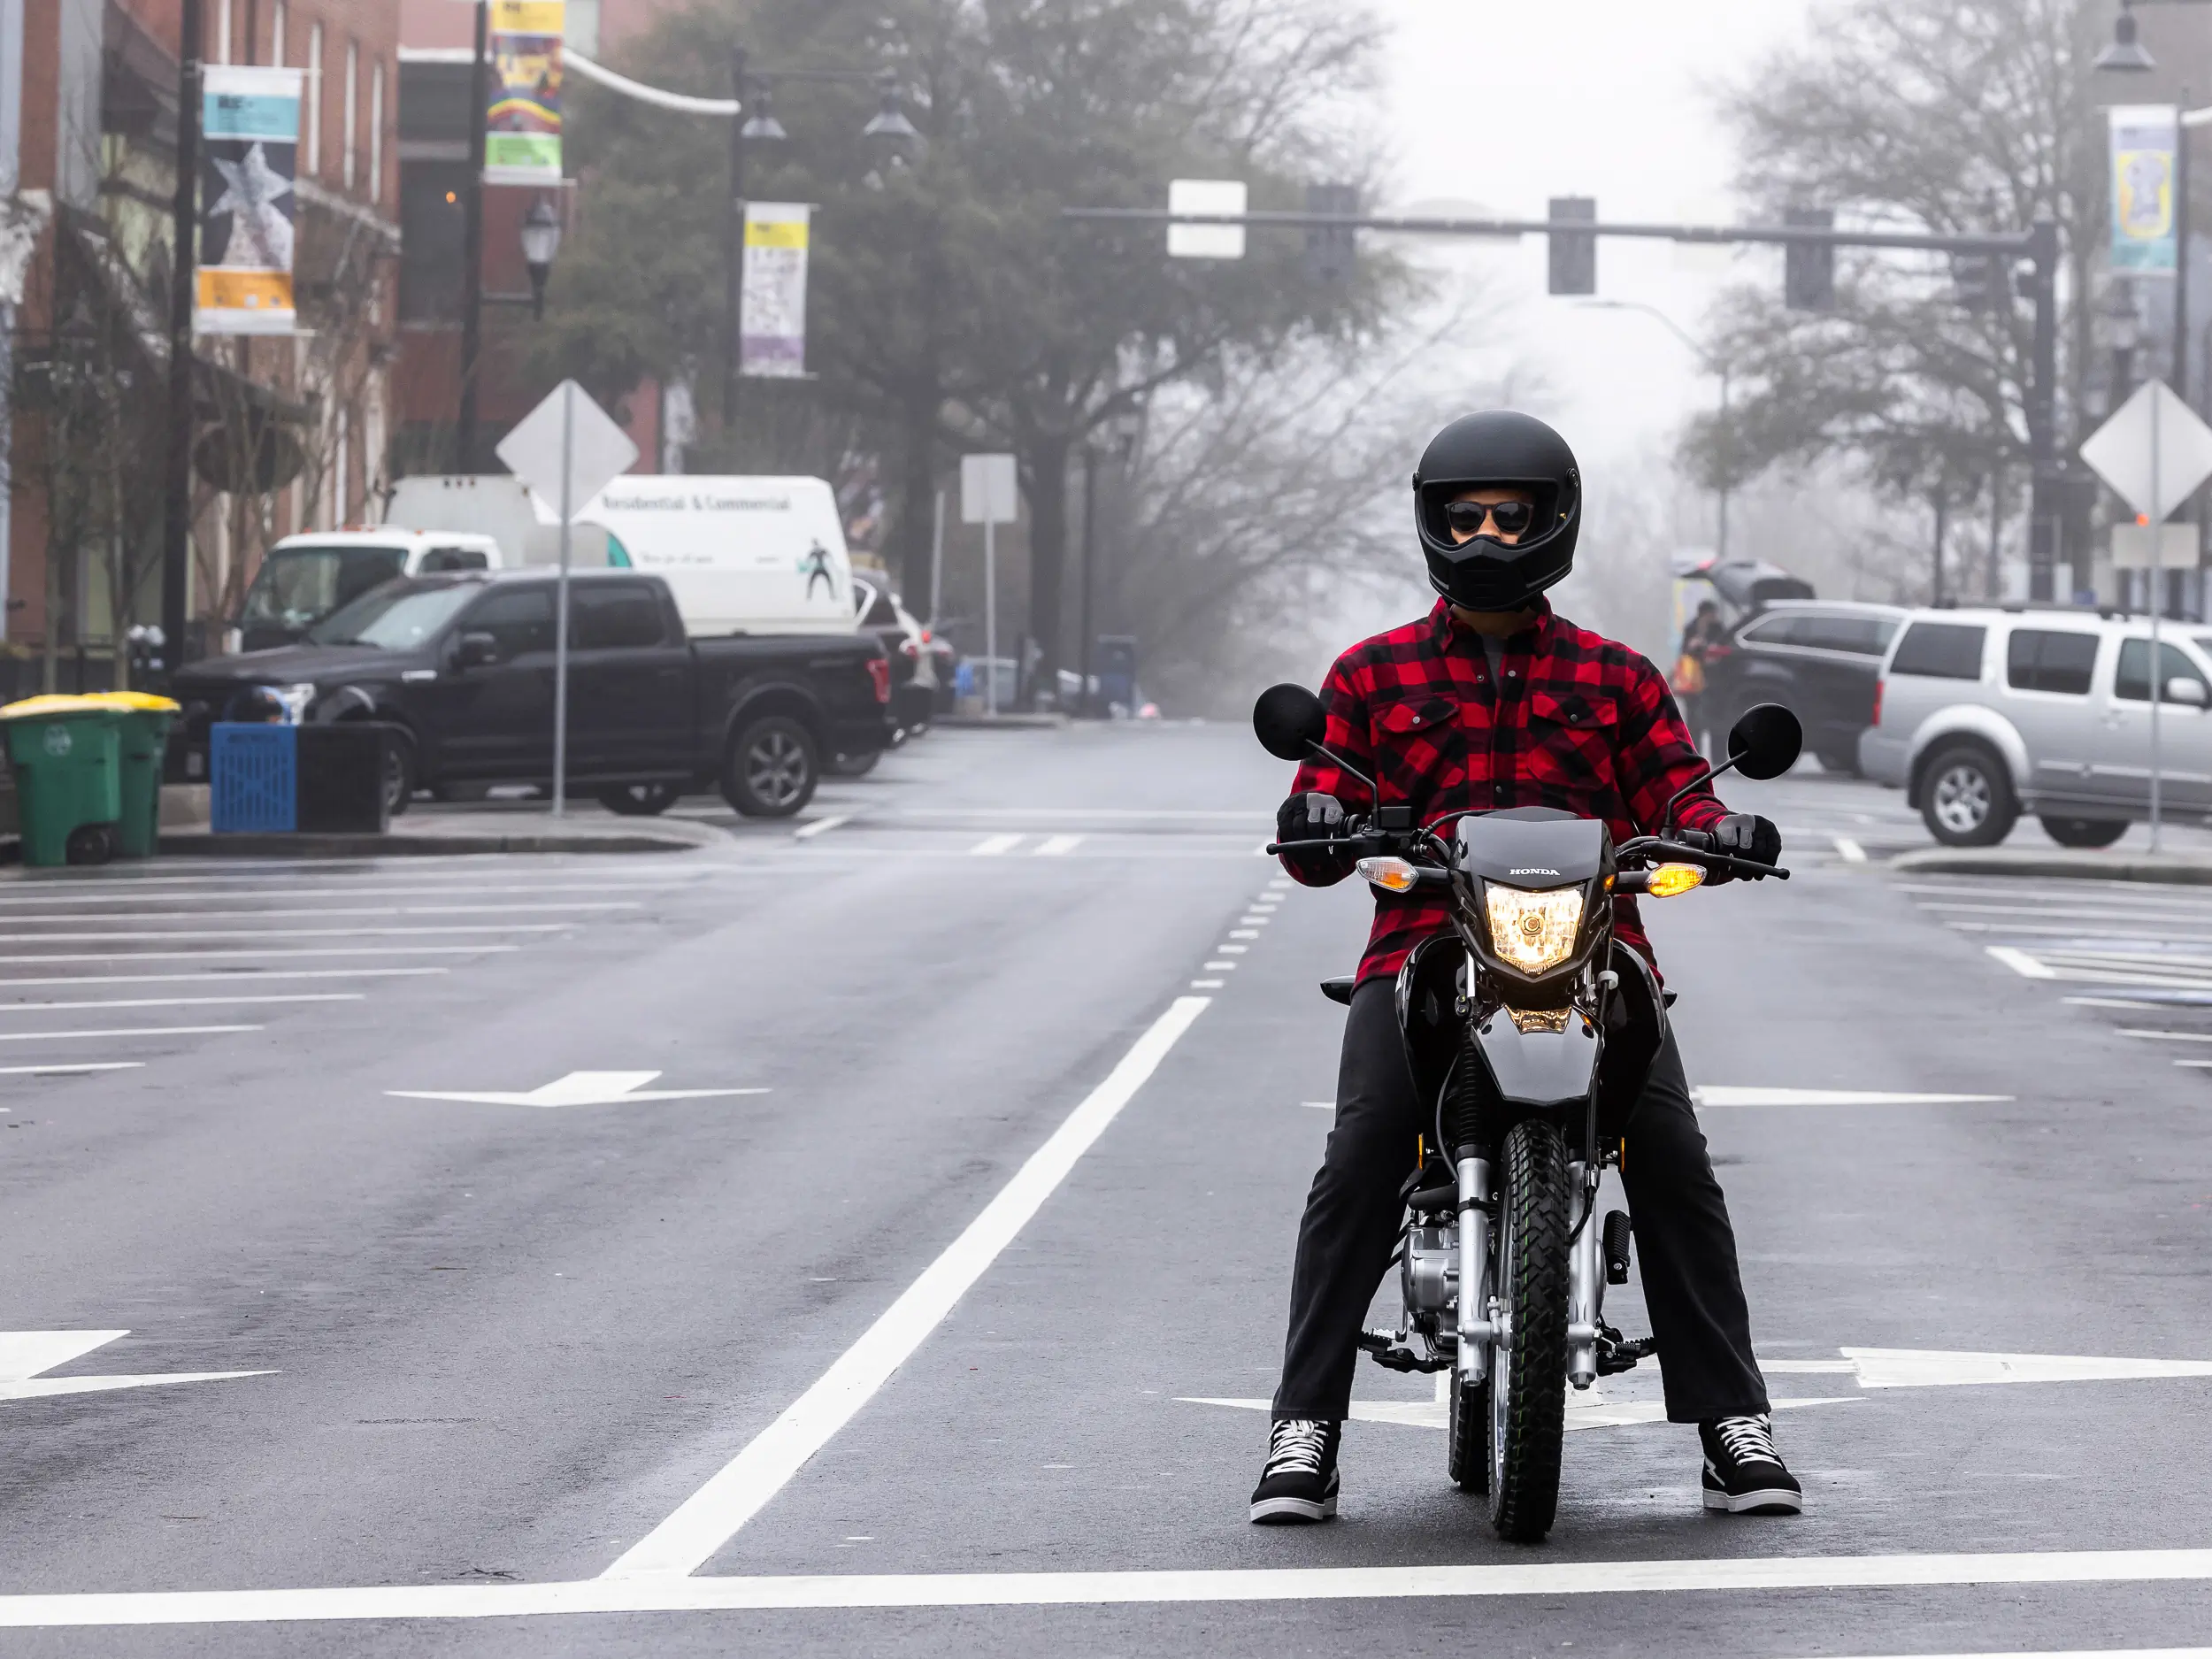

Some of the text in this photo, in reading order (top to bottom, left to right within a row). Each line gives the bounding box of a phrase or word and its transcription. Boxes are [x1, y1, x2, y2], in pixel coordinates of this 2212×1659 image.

[602, 495, 790, 511] Residential & Commercial
